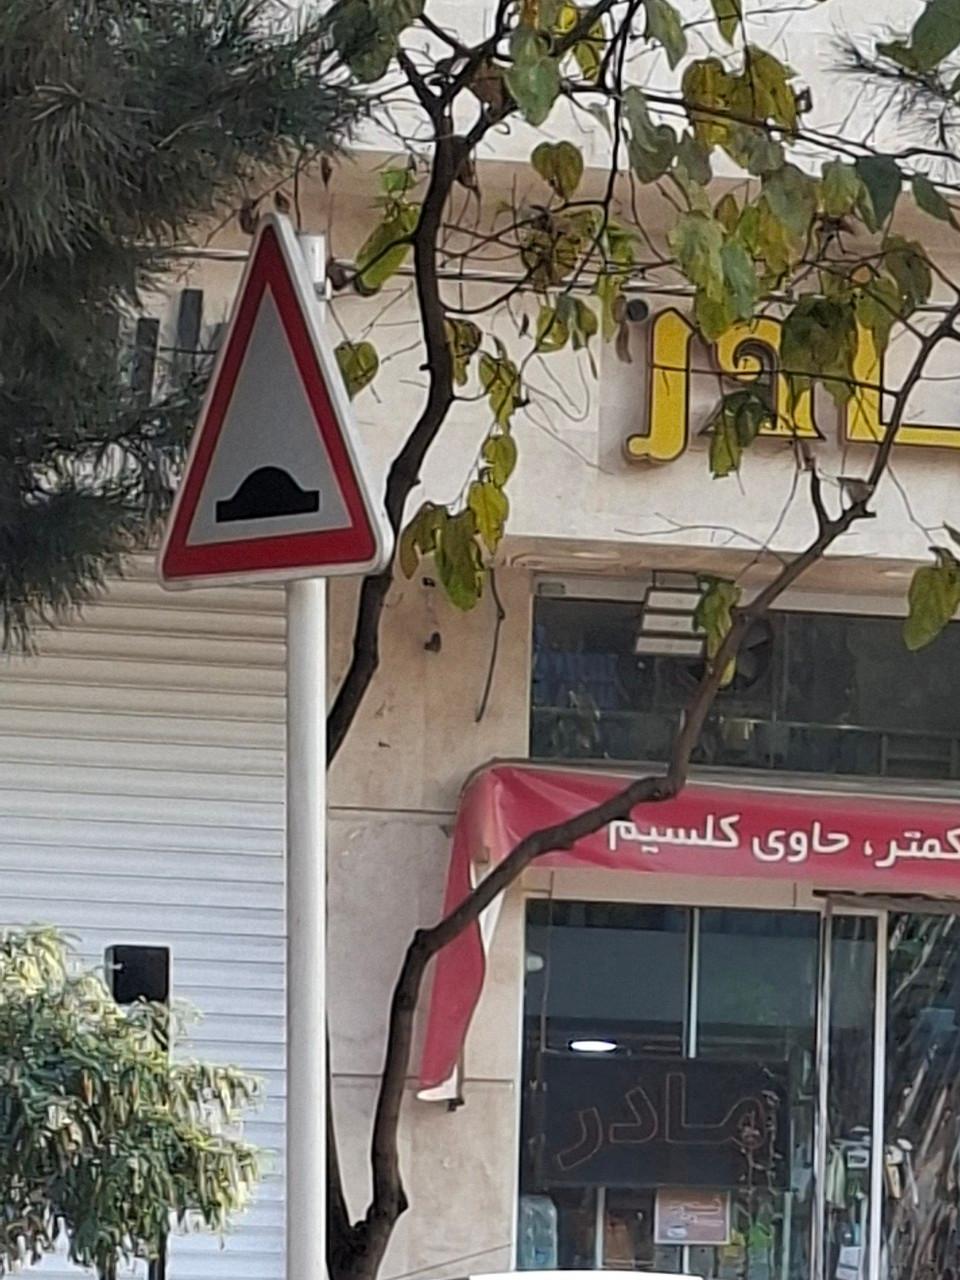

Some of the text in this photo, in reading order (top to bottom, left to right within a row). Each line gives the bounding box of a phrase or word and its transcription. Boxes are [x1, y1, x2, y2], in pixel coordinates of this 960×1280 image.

[607, 814, 741, 854] کلسیم
[752, 820, 850, 863] حاوی
[556, 1071, 767, 1171] مادر
